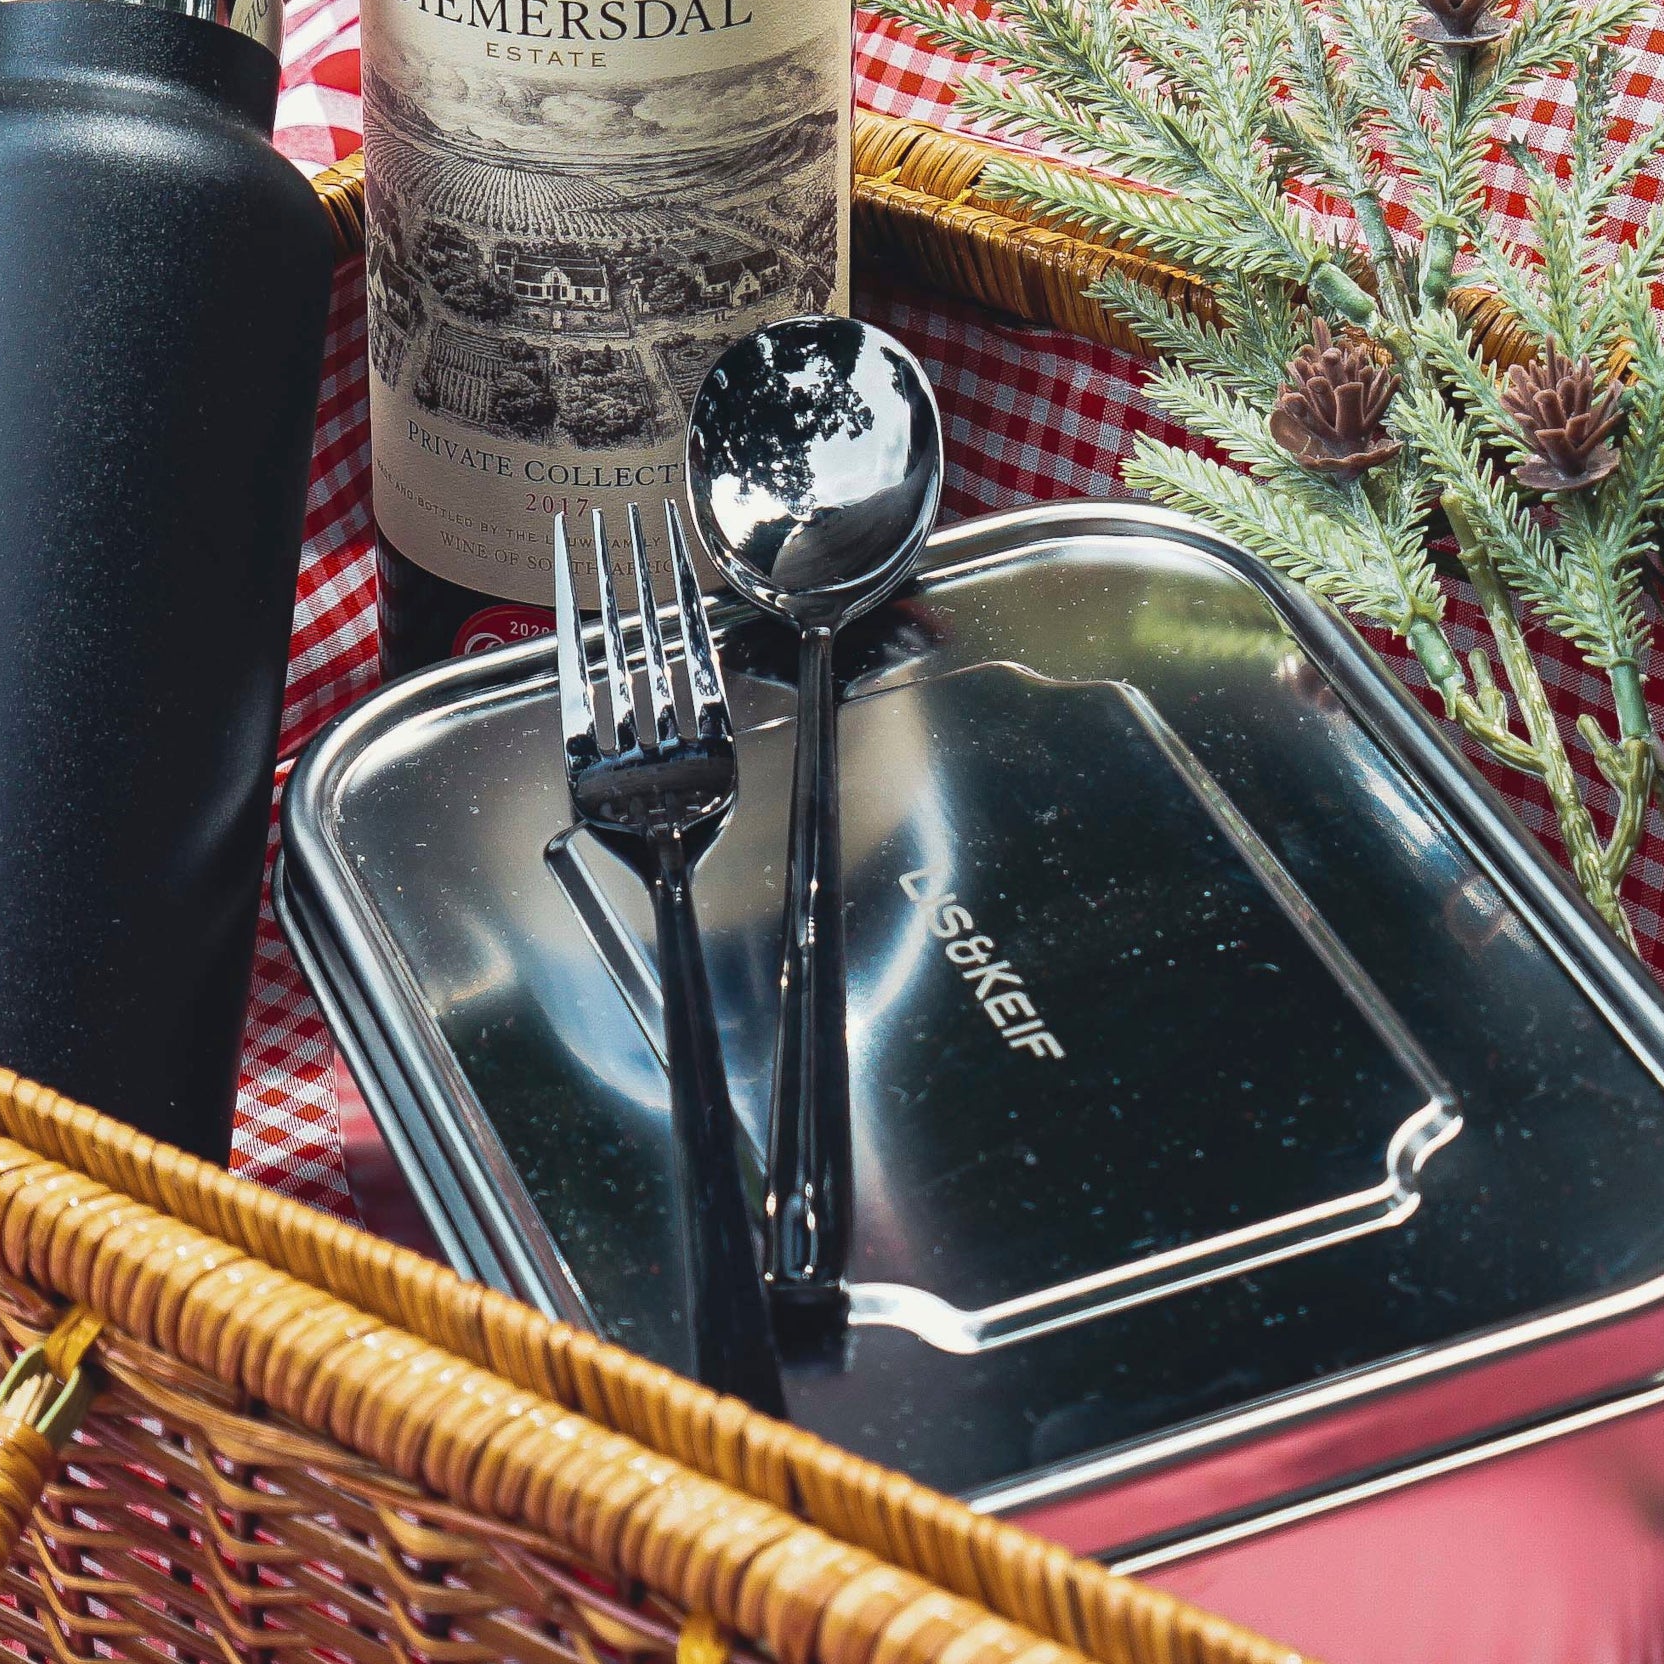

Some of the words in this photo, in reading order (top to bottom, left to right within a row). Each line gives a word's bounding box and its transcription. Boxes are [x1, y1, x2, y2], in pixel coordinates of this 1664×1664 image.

[486, 42, 607, 68] ESTATE
[406, 419, 513, 478] PRIVATE
[417, 495, 473, 528] BOTTLED
[480, 521, 499, 535] BY
[506, 528, 537, 543] THE
[545, 535, 593, 549] LUW
[606, 536, 661, 549] AMLY
[525, 493, 590, 517] 2017
[440, 530, 488, 560] WINE
[494, 549, 520, 566] OF
[527, 555, 597, 575] SOTH
[611, 559, 673, 576] AFIC
[898, 865, 1067, 1060] LIS&KEIF
